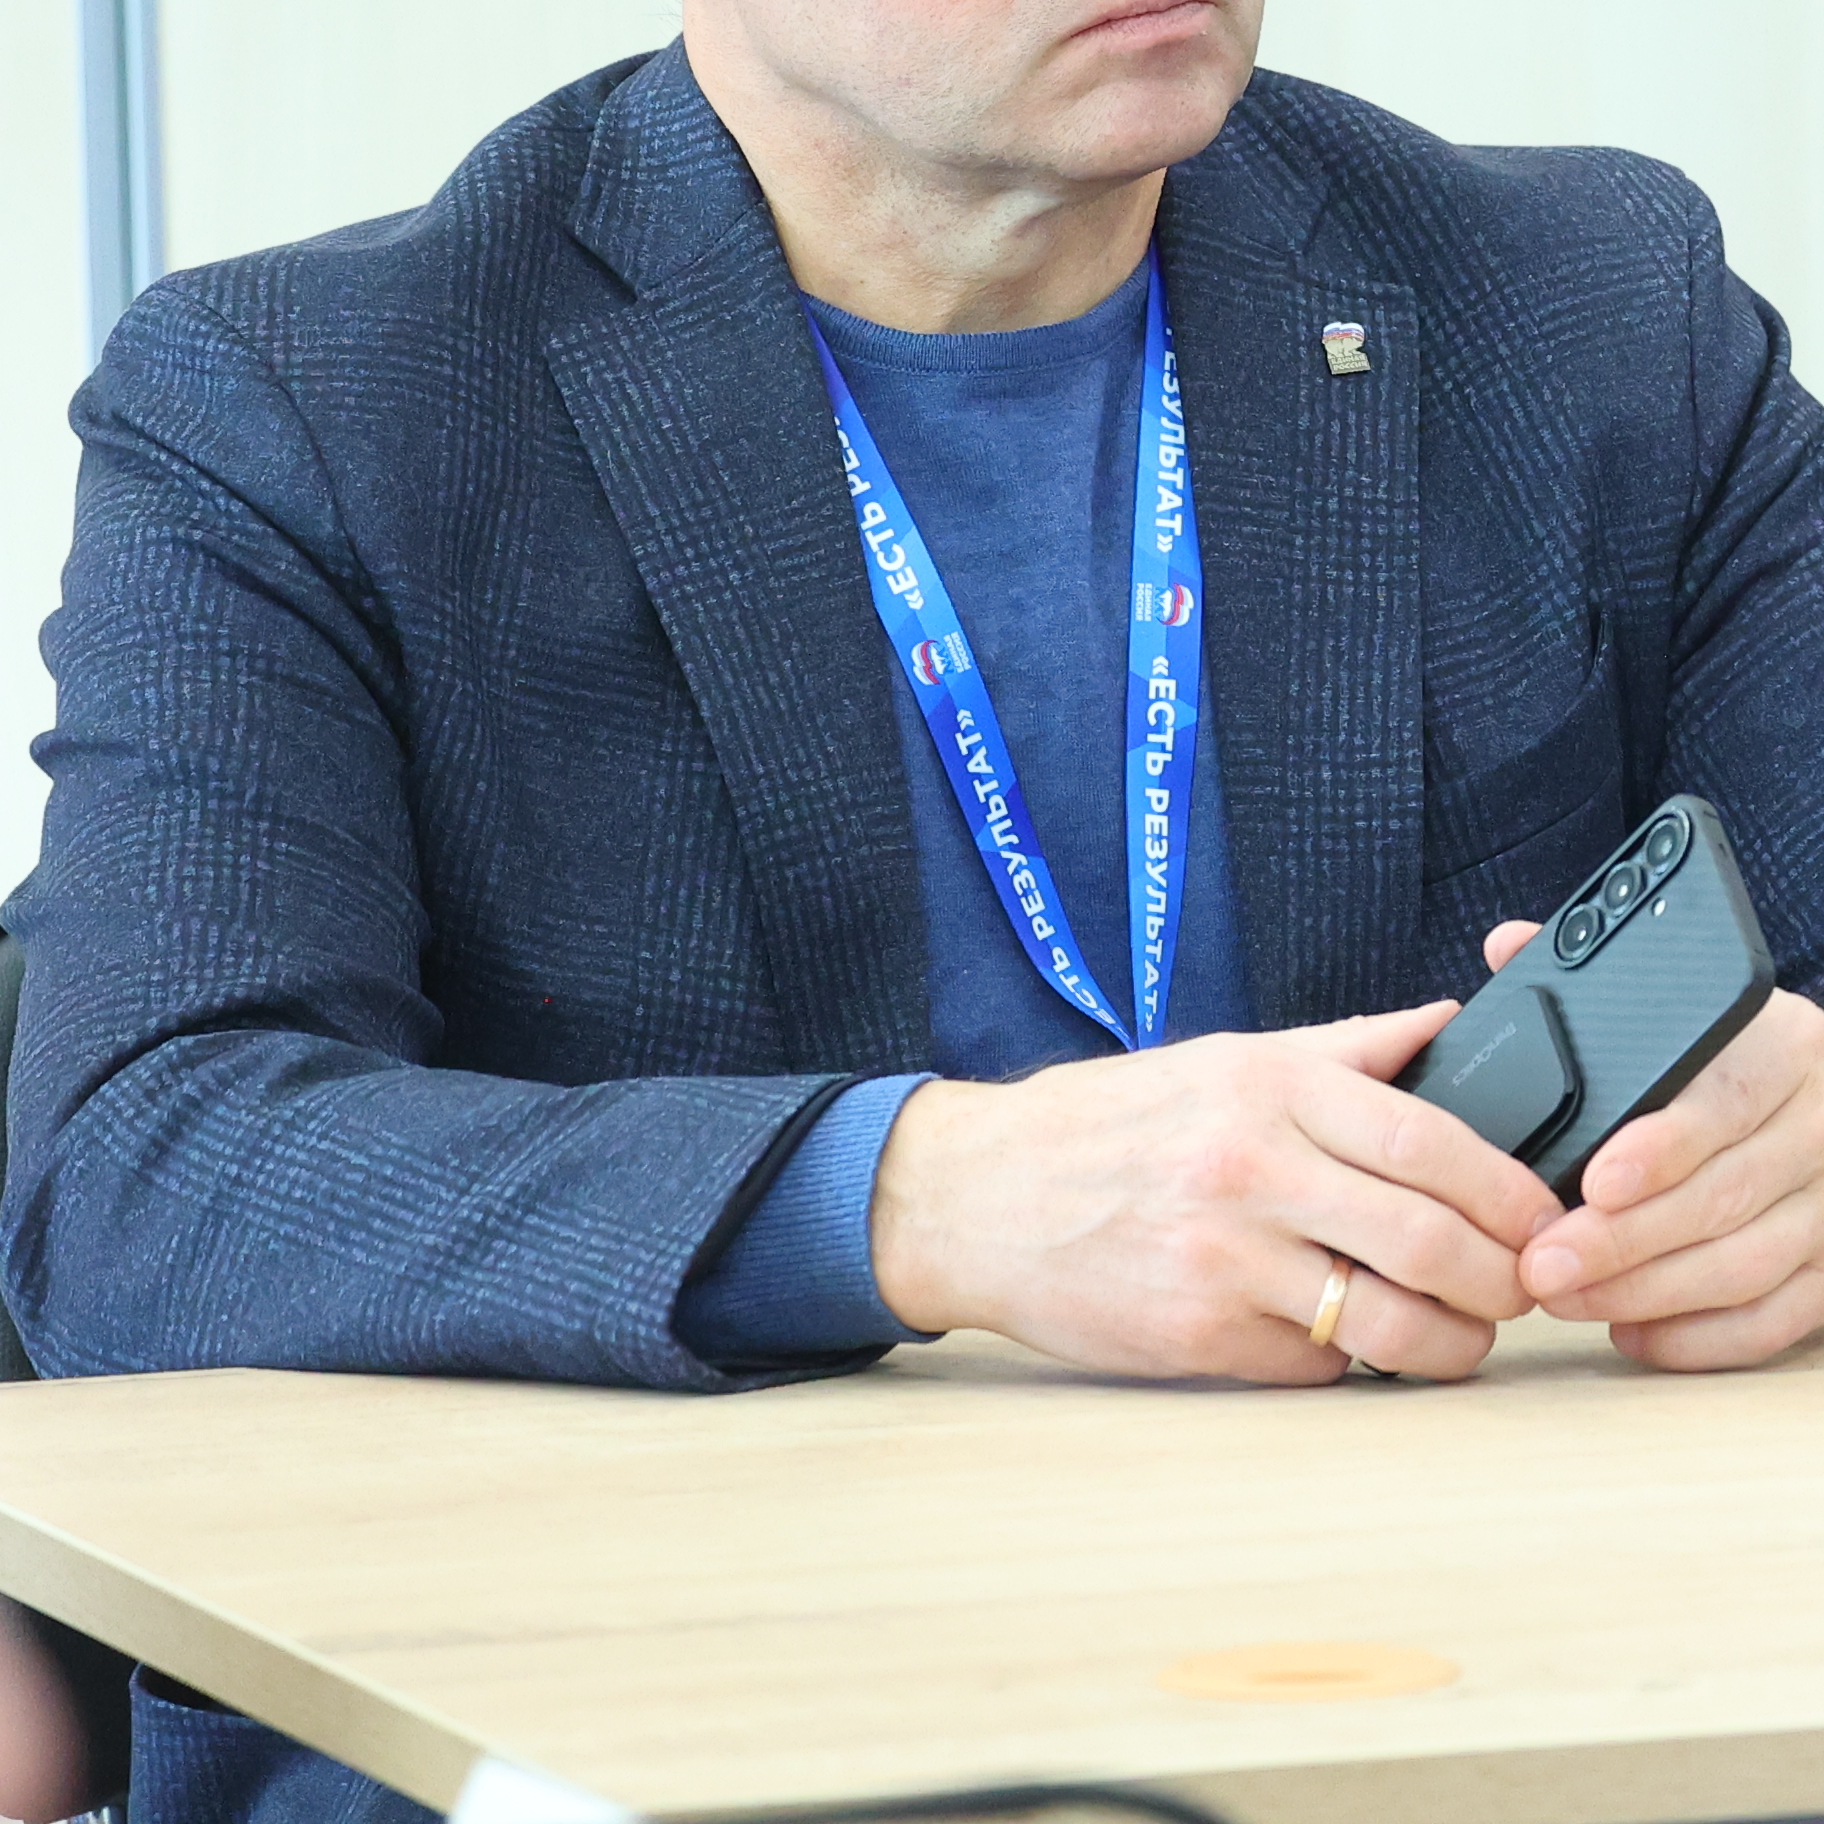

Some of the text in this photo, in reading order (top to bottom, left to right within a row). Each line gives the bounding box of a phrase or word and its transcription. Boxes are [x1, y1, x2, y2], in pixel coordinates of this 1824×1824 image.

[861, 501, 925, 610] «ЕСТЬ
[1154, 327, 1187, 554] ЕЗУЛЬТАТ»
[955, 709, 1056, 942] РЕЗУЛЬТАТ»
[1143, 655, 1177, 1033] «ЕСТЬ РЕЗУЛЬТАТ»
